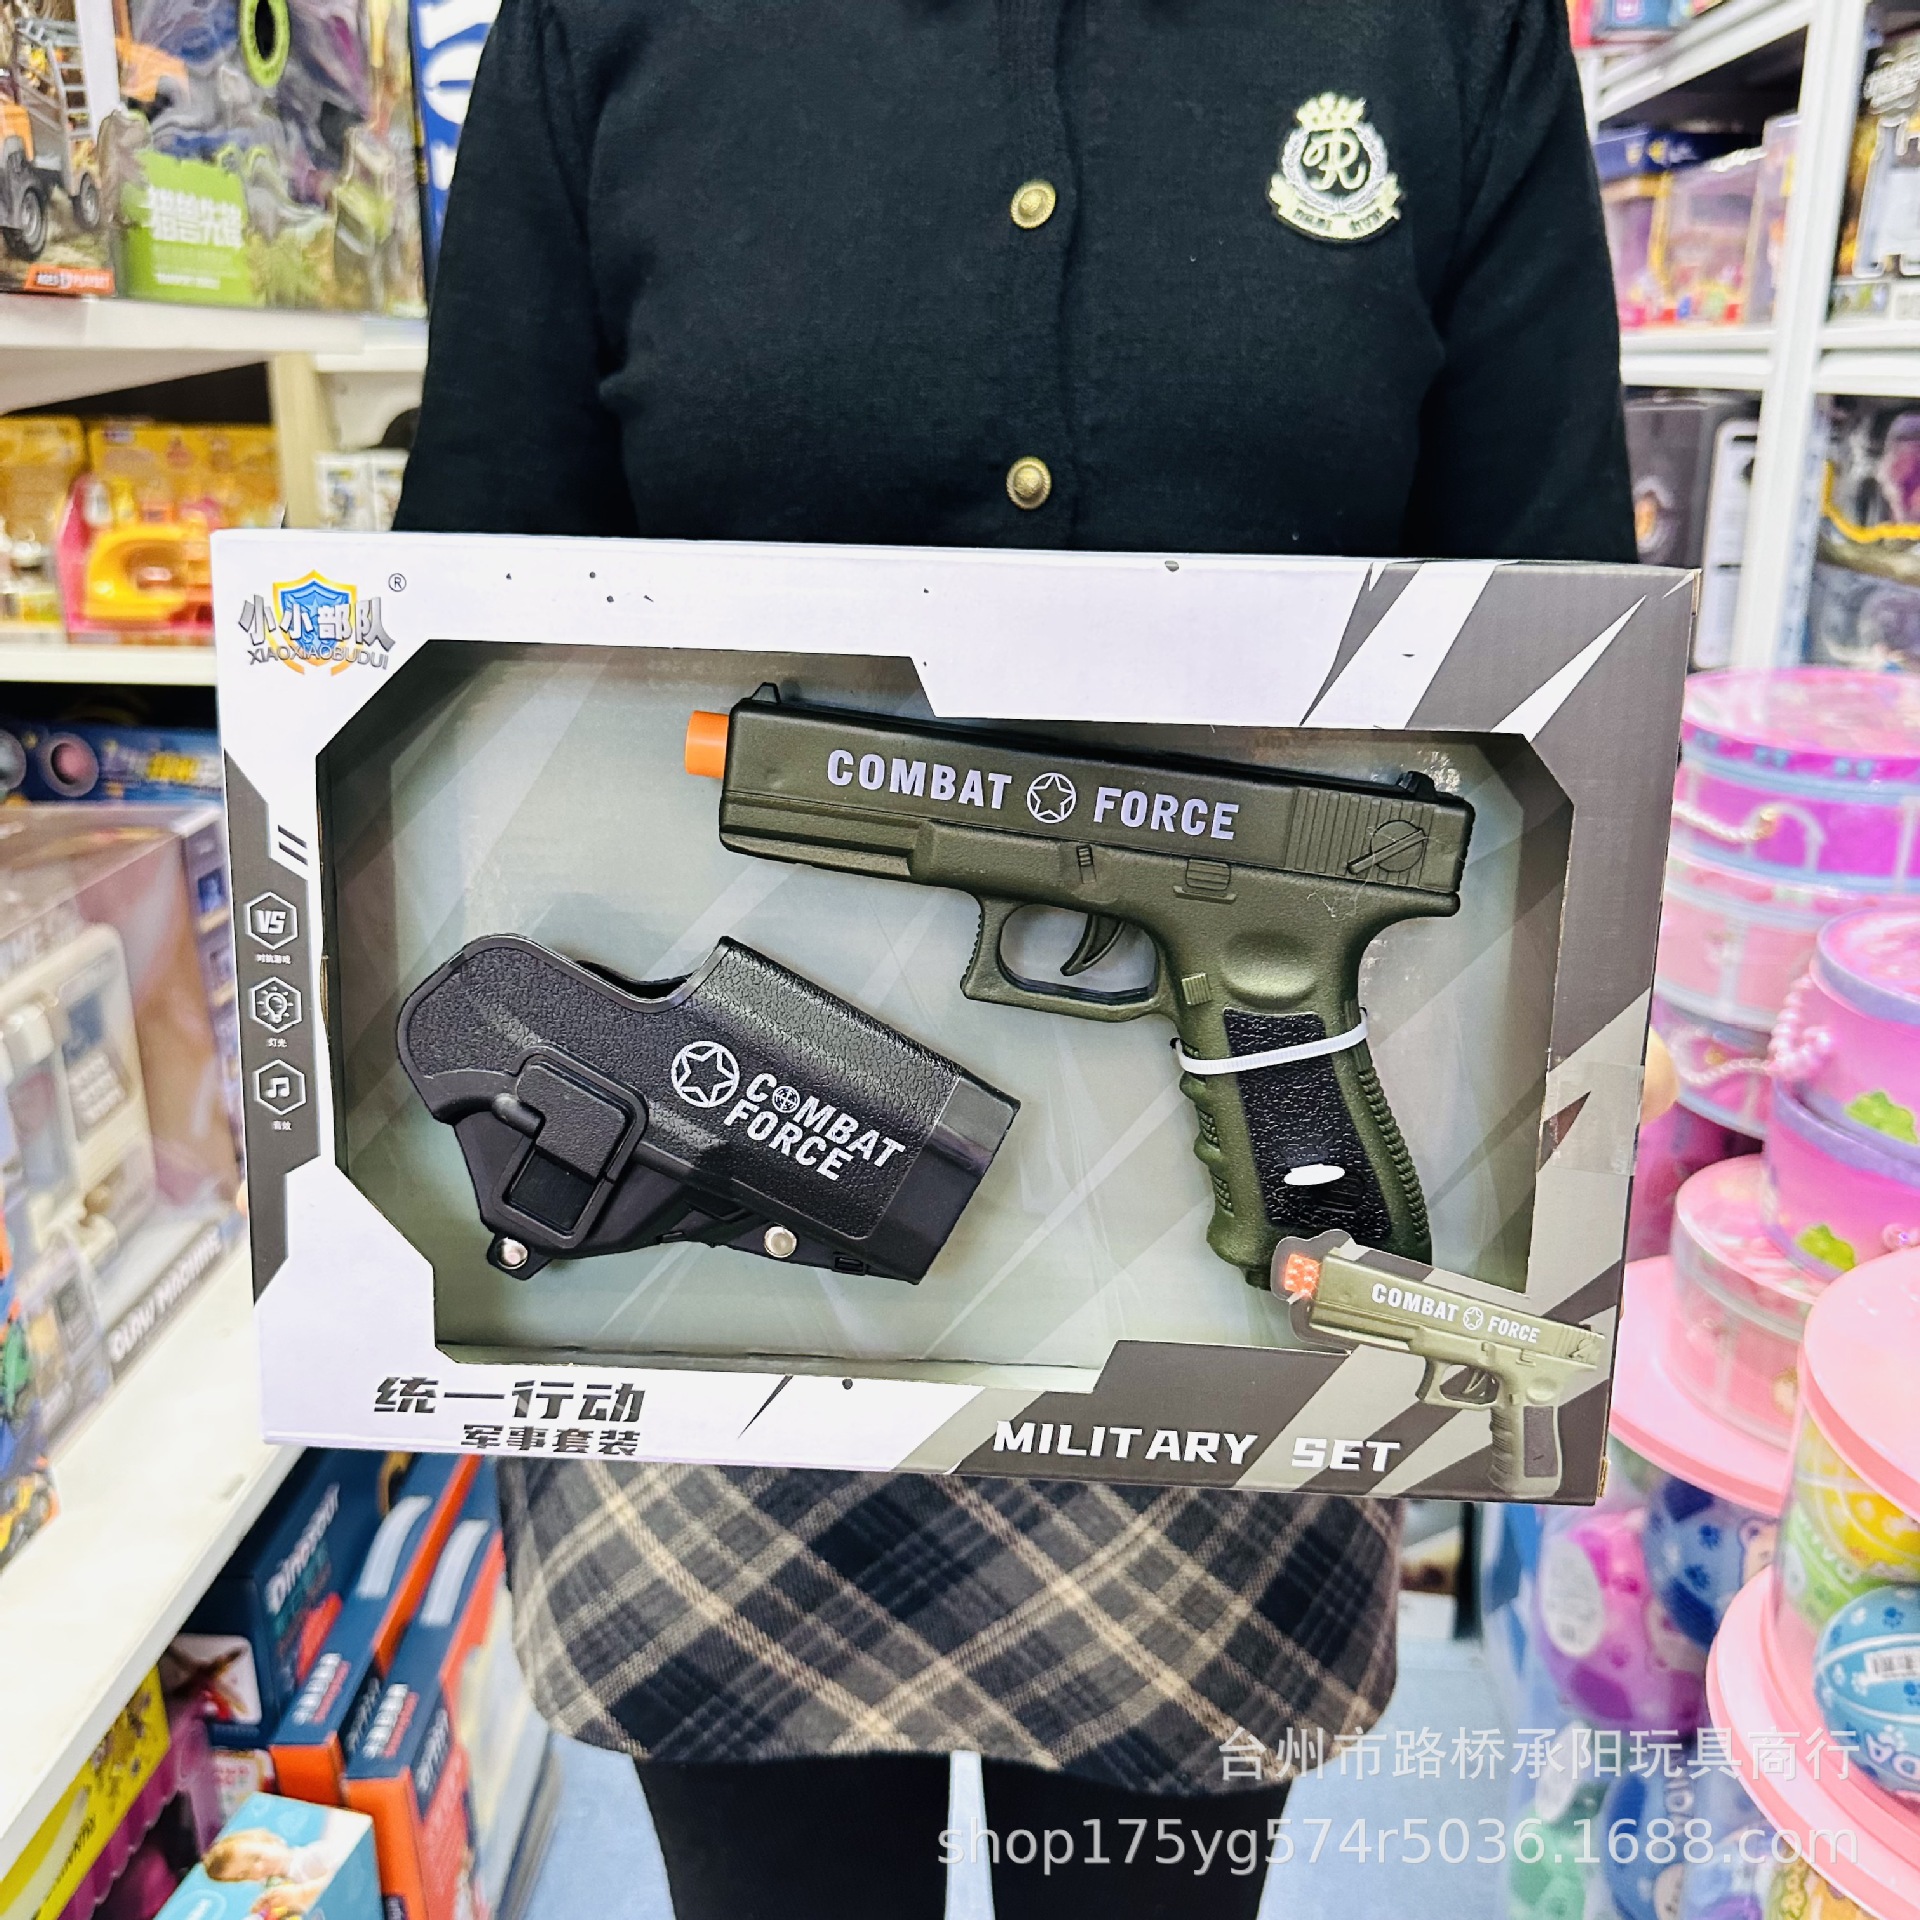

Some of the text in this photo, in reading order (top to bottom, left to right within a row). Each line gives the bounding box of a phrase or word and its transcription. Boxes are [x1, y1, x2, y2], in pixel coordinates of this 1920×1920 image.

[238, 594, 396, 651] 小小部队
[247, 645, 389, 670] XIAOXIAOBUDUI
[827, 749, 1240, 841] COMBAT FORCE
[255, 909, 287, 935] VS
[267, 1037, 288, 1049] 灯光
[723, 1098, 855, 1182] FORCE
[746, 1072, 906, 1168] COMBAT
[1371, 1283, 1541, 1344] COMBAT FORCE
[374, 1376, 646, 1423] 统一行动
[461, 1424, 641, 1456] 军事套装
[992, 1420, 1401, 1473] MILITARY SET
